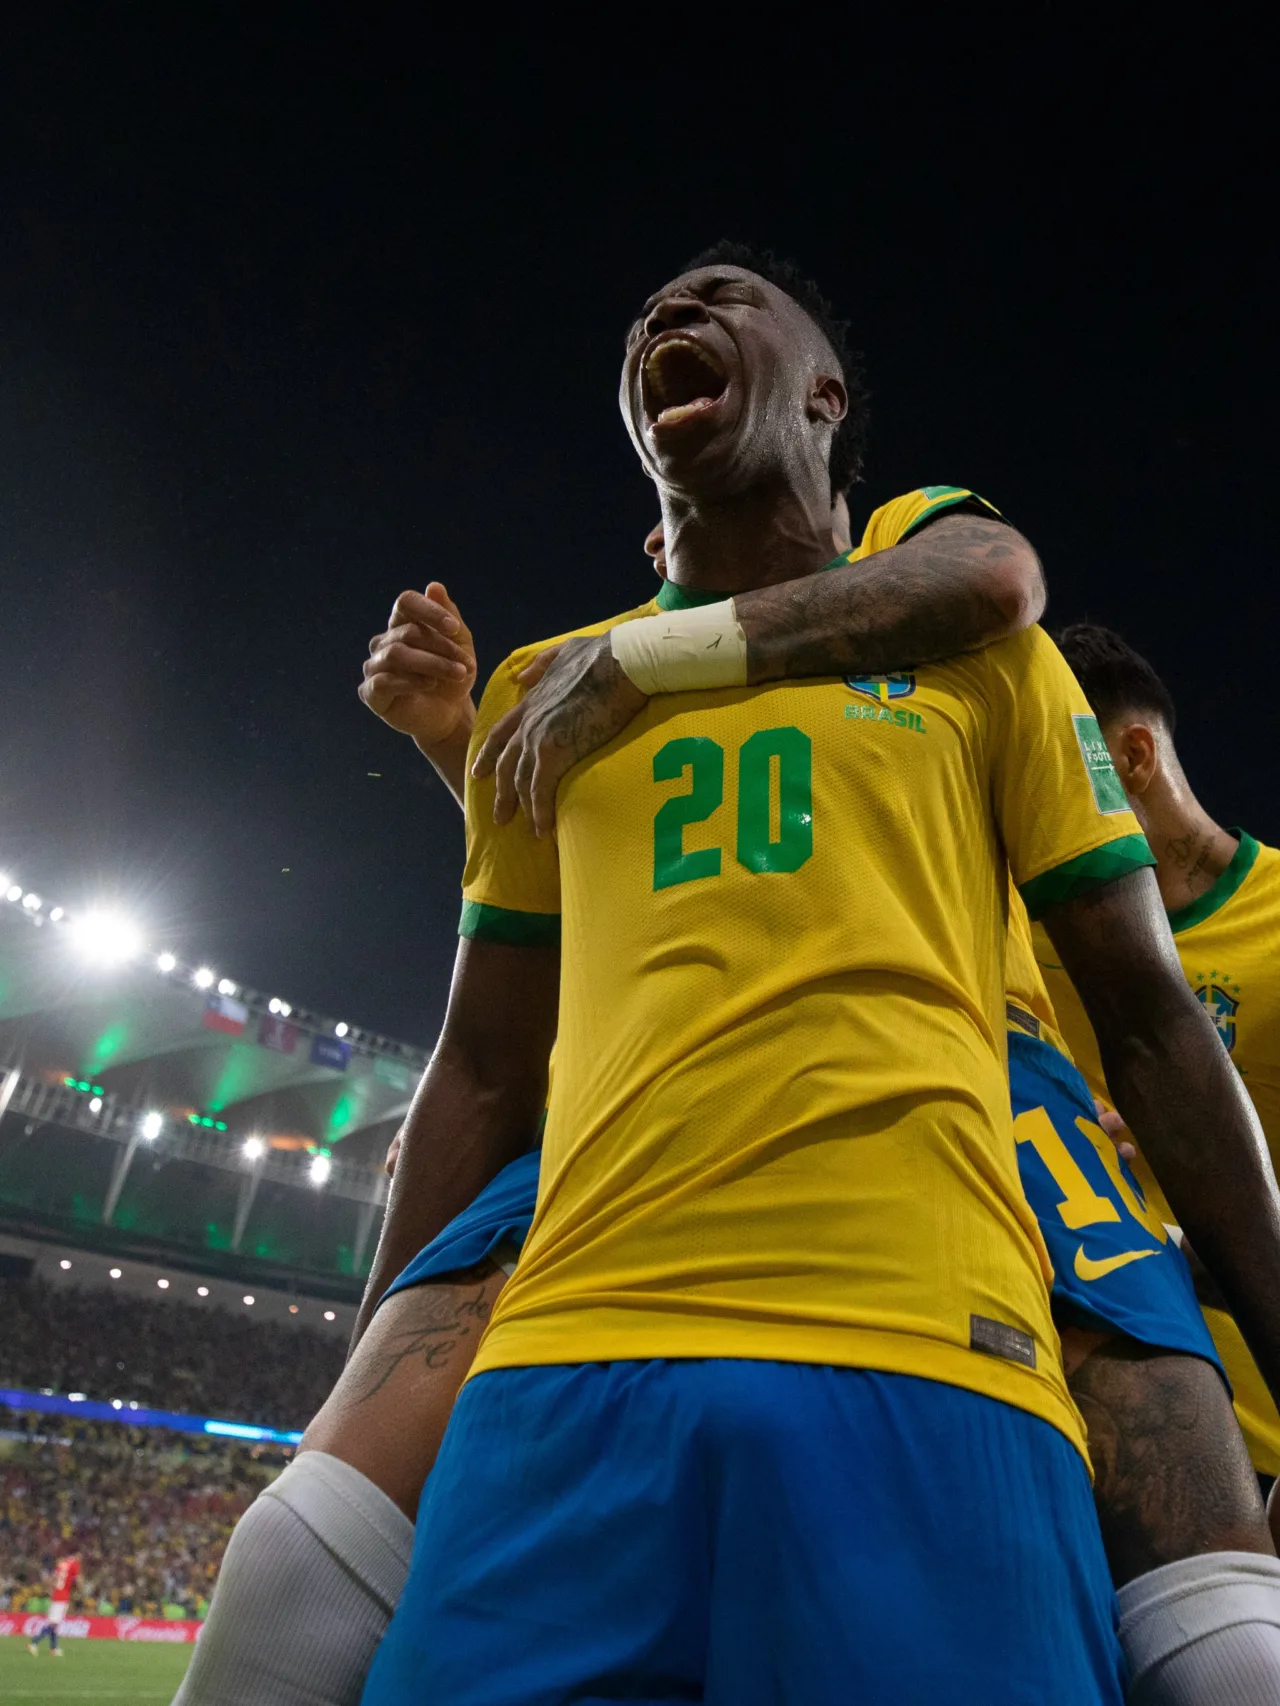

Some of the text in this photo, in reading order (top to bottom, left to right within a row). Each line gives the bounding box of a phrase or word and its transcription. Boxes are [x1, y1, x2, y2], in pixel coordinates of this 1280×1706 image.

[844, 704, 927, 735] BRASIL
[653, 726, 814, 892] 20
[1013, 1105, 1168, 1246] 10
